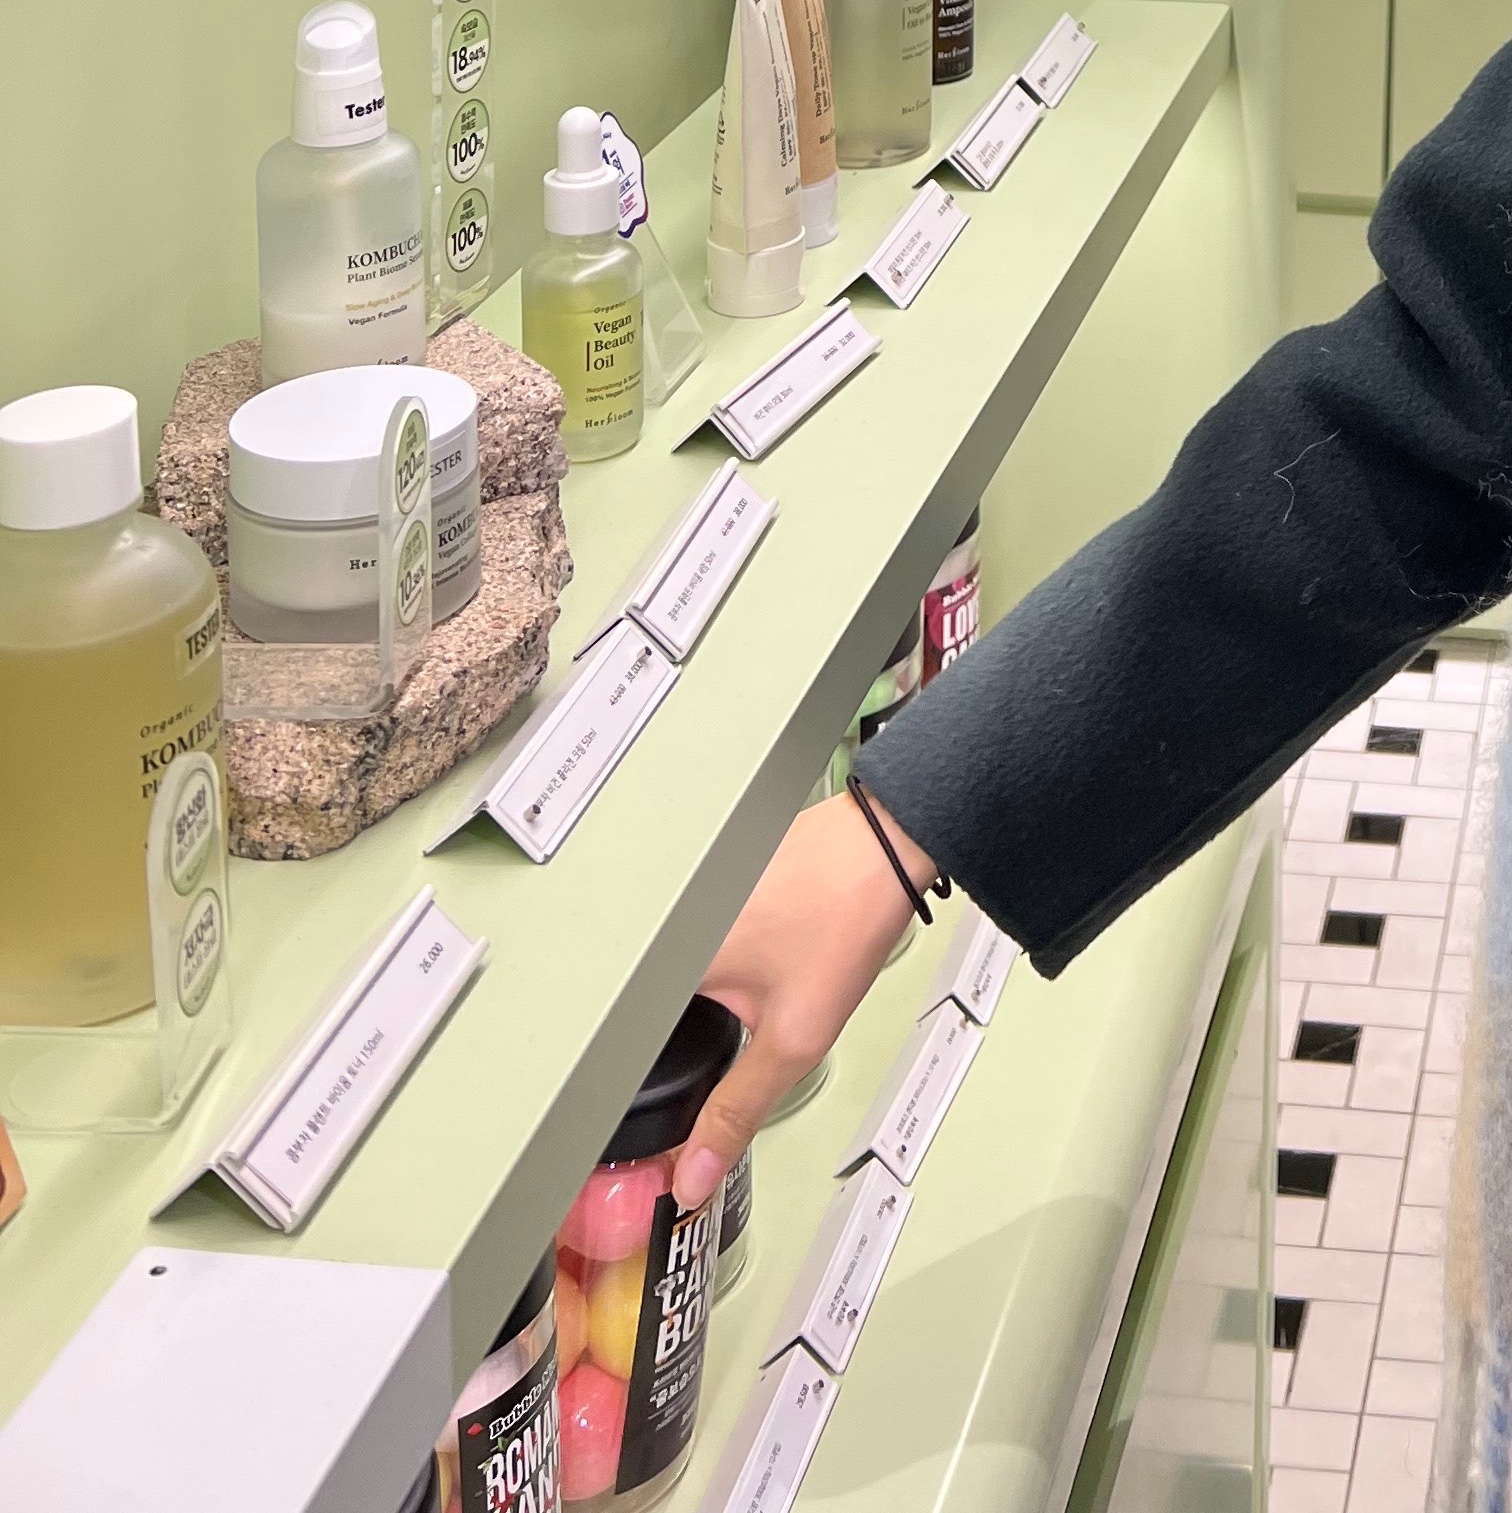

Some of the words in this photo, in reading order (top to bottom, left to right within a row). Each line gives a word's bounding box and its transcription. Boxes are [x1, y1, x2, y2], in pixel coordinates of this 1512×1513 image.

[452, 132, 484, 166] 100%
[451, 221, 483, 256] 100%
[347, 269, 377, 283] Plant
[379, 260, 408, 278] Biome
[348, 314, 376, 326] Vegan
[593, 314, 632, 334] Vegan
[593, 329, 636, 353] Beauty
[593, 353, 615, 371] Oil
[430, 450, 462, 479] ESTER
[140, 704, 193, 738] Organic
[581, 727, 598, 749] 50ml
[360, 1026, 386, 1060] 150ml
[490, 1384, 543, 1438] Bubble
